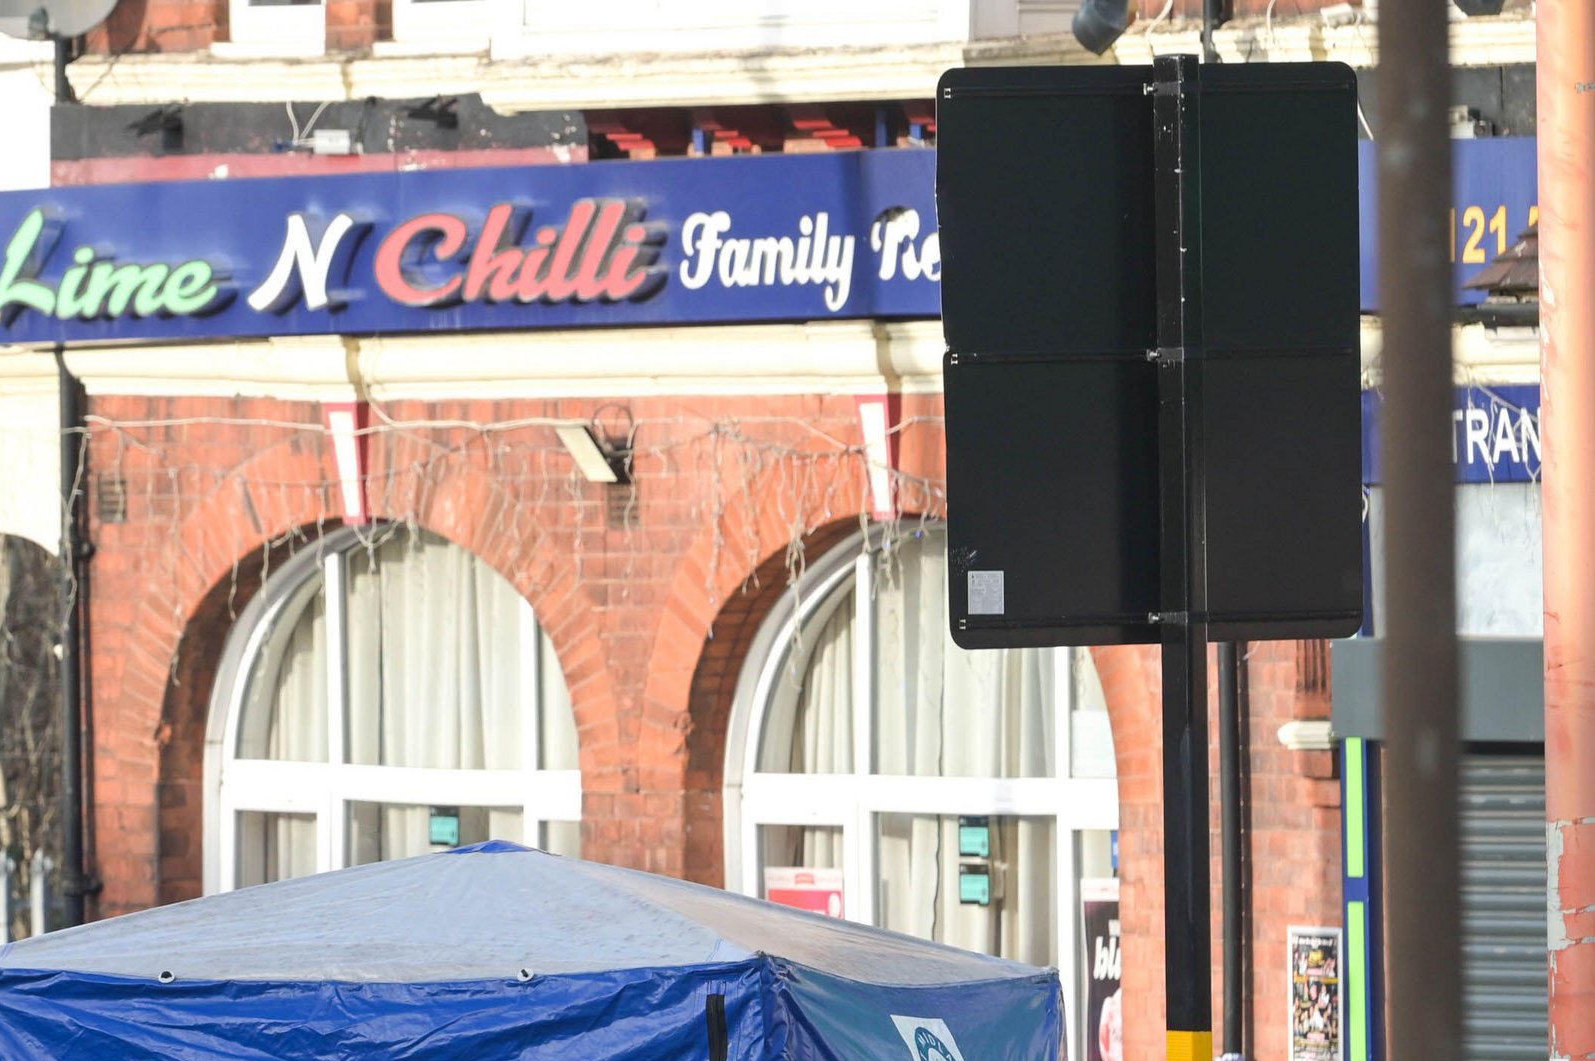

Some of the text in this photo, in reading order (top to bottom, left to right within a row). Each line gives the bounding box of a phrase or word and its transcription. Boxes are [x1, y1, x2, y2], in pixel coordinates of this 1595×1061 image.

[247, 212, 354, 311] N
[374, 198, 647, 306] Chilli
[680, 210, 855, 312] Family
